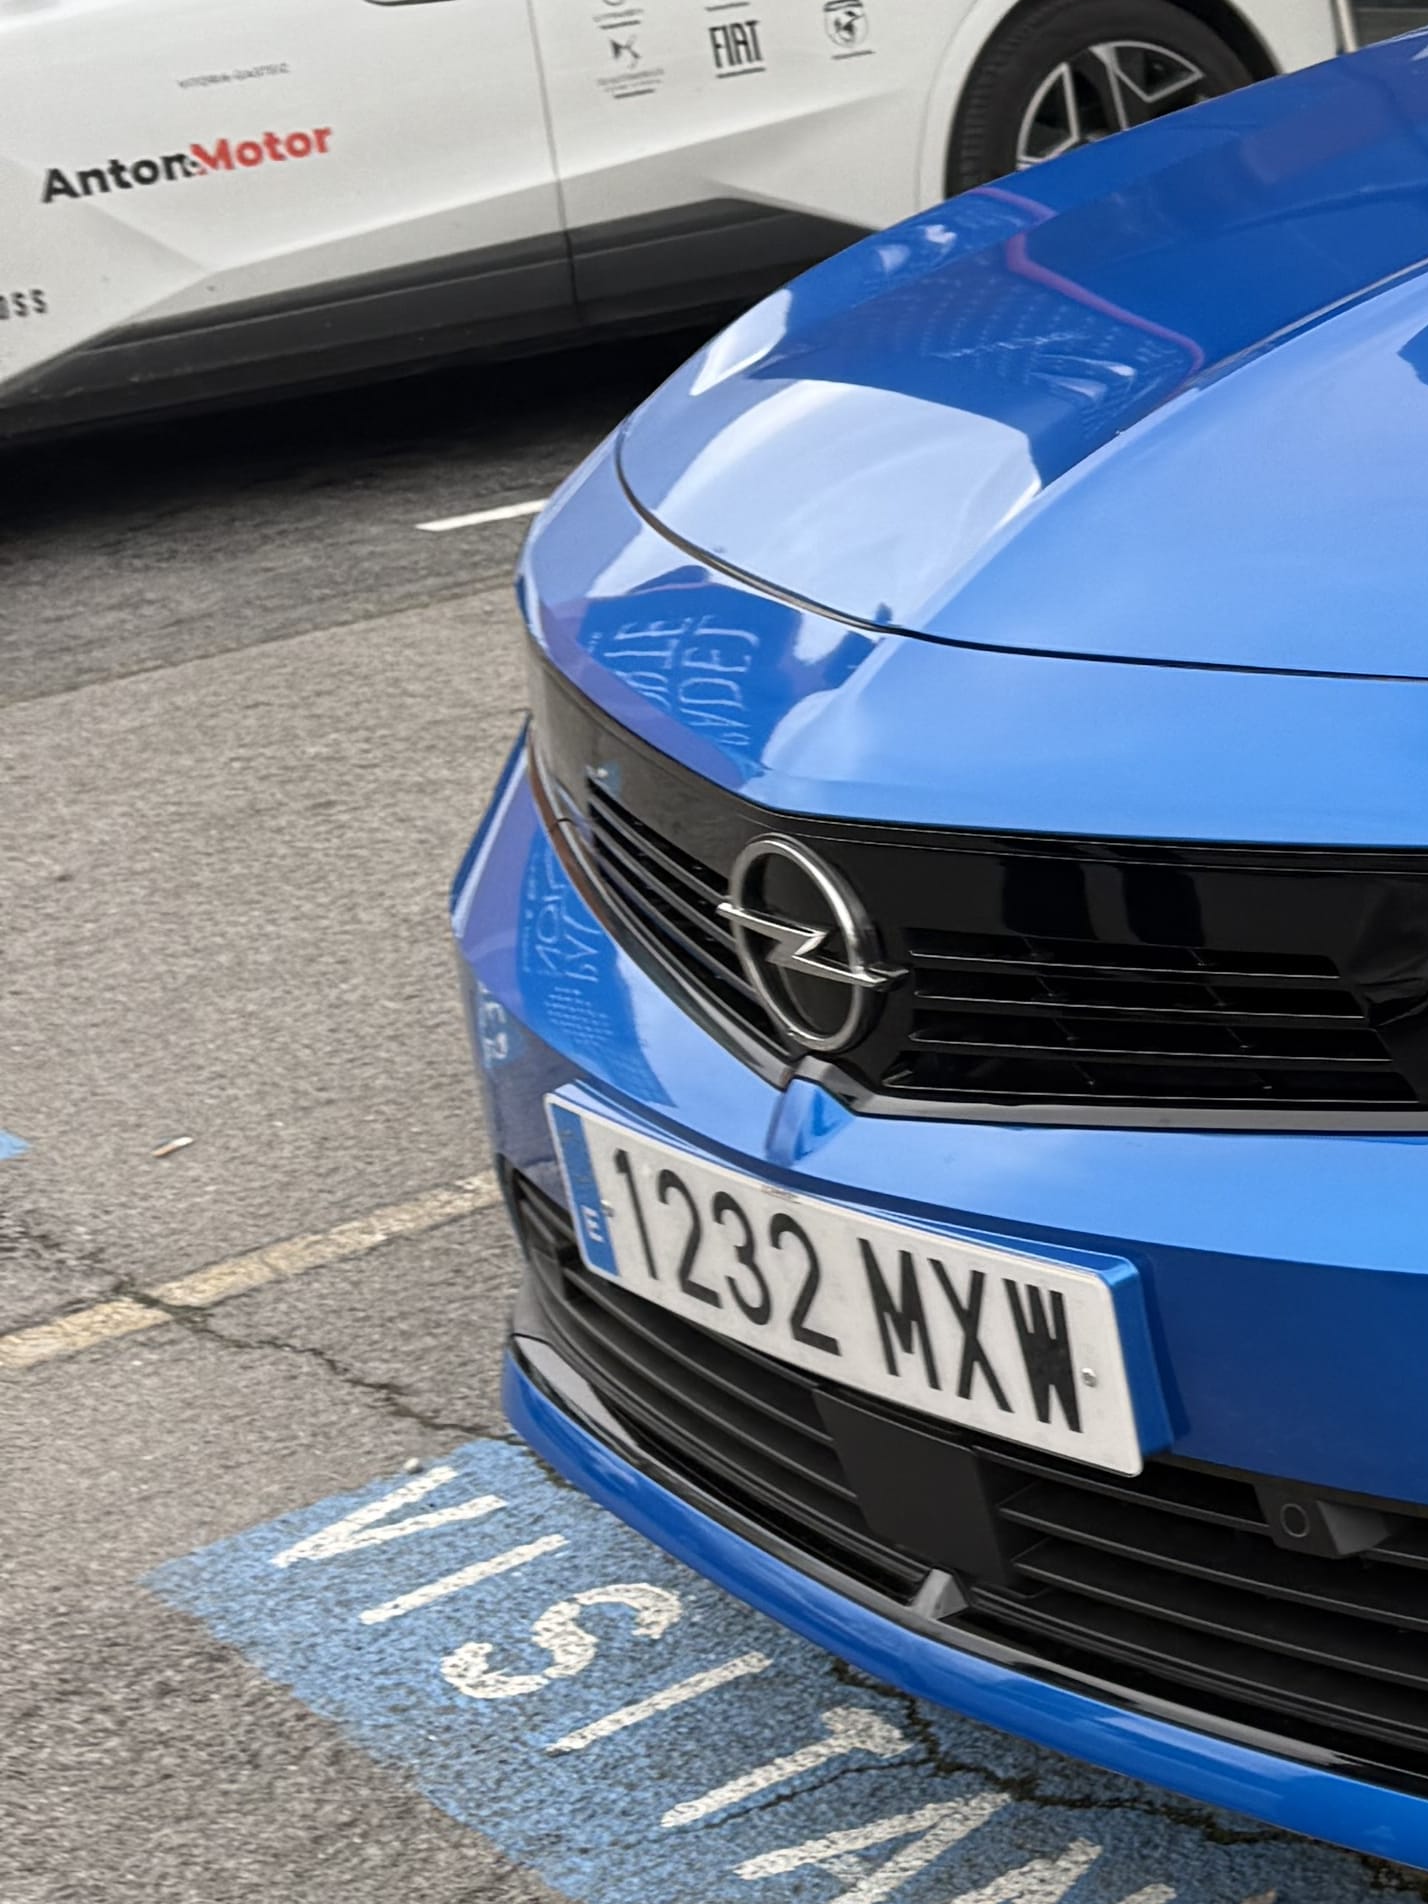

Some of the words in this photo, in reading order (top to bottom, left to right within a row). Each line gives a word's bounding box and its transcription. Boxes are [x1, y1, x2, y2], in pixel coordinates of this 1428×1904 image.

[708, 19, 763, 69] FIAT
[613, 1149, 842, 1357] 1232
[858, 1236, 1084, 1434] MXW
